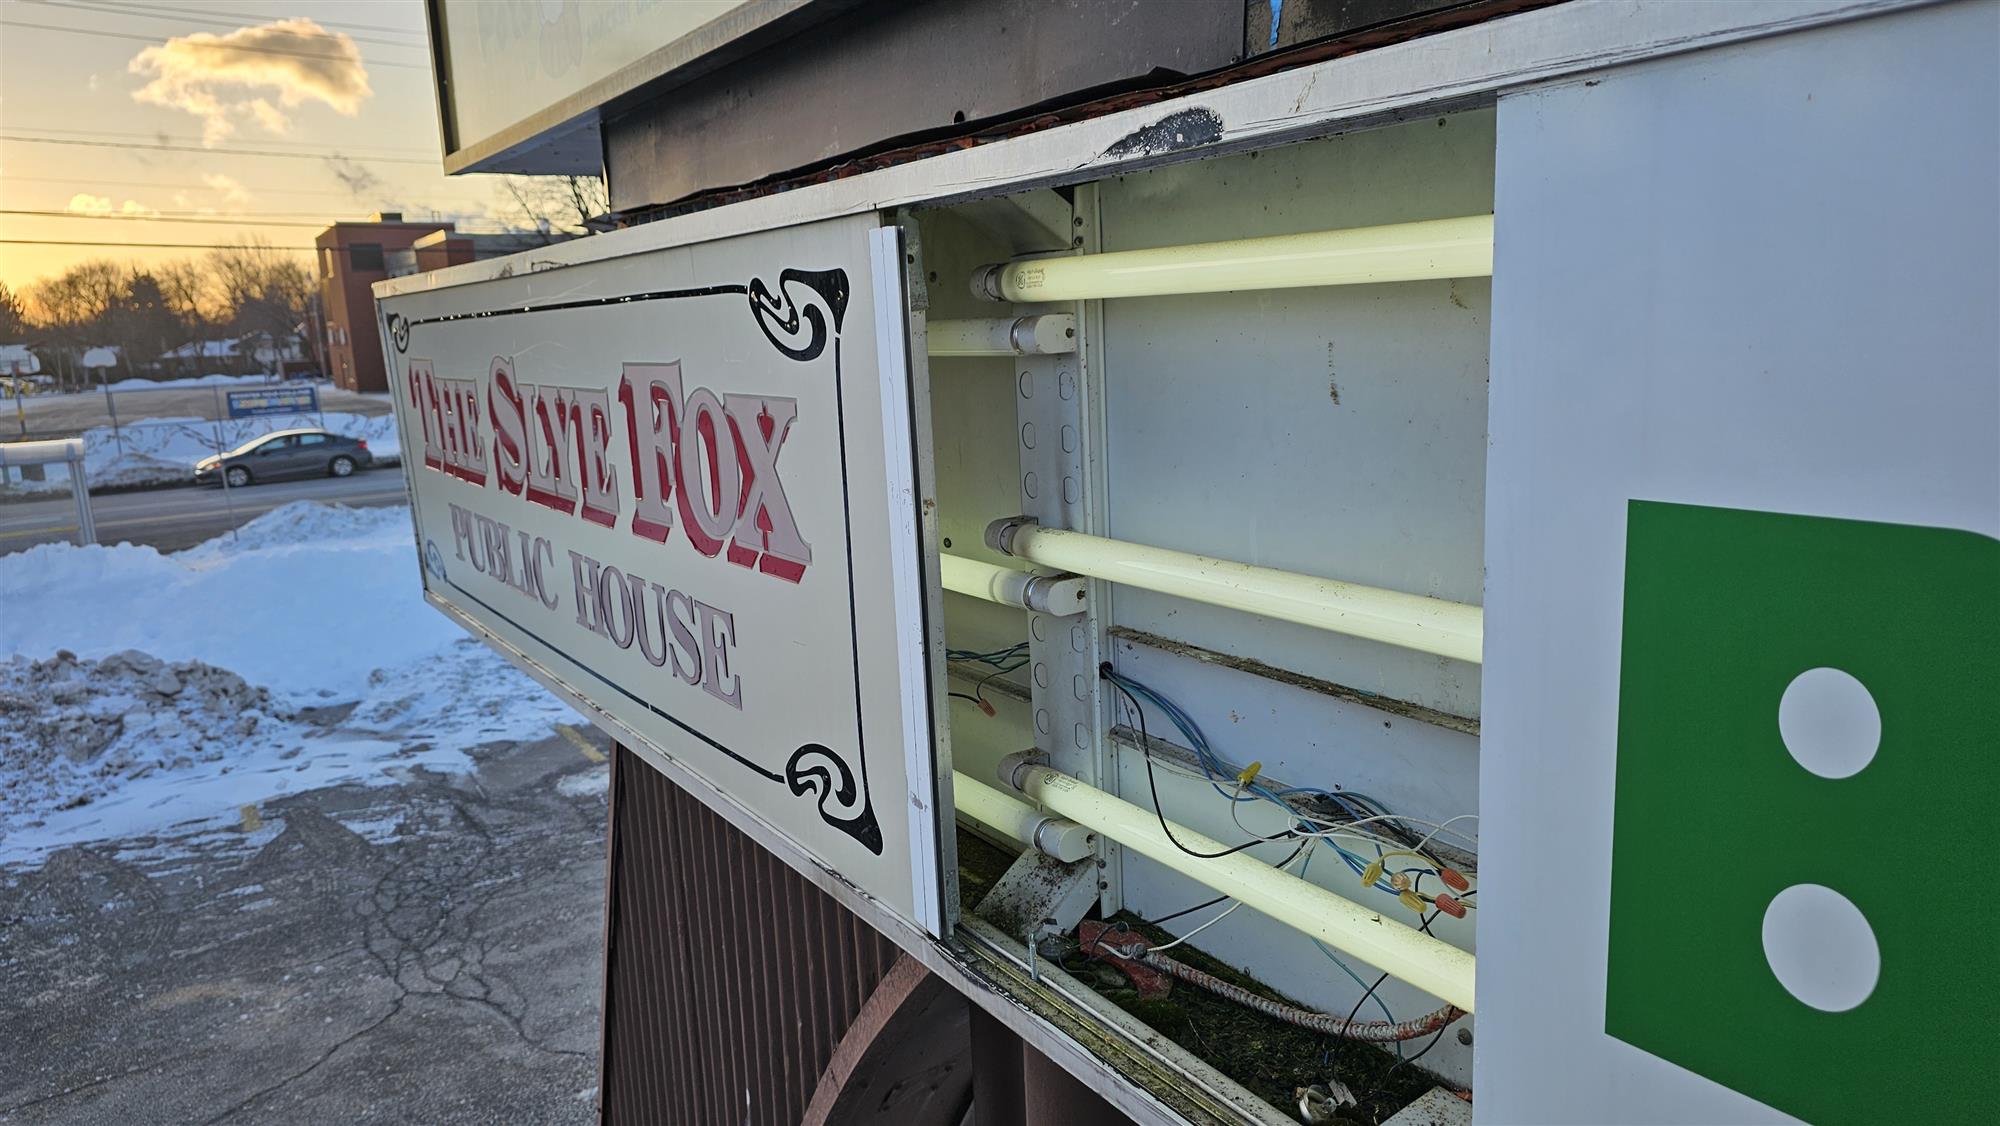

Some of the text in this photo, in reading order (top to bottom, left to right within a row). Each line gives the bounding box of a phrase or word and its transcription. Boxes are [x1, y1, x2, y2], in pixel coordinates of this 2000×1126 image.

[409, 356, 812, 585] THE SLYE FOX
[449, 502, 743, 711] PUBLIC HOUSE
